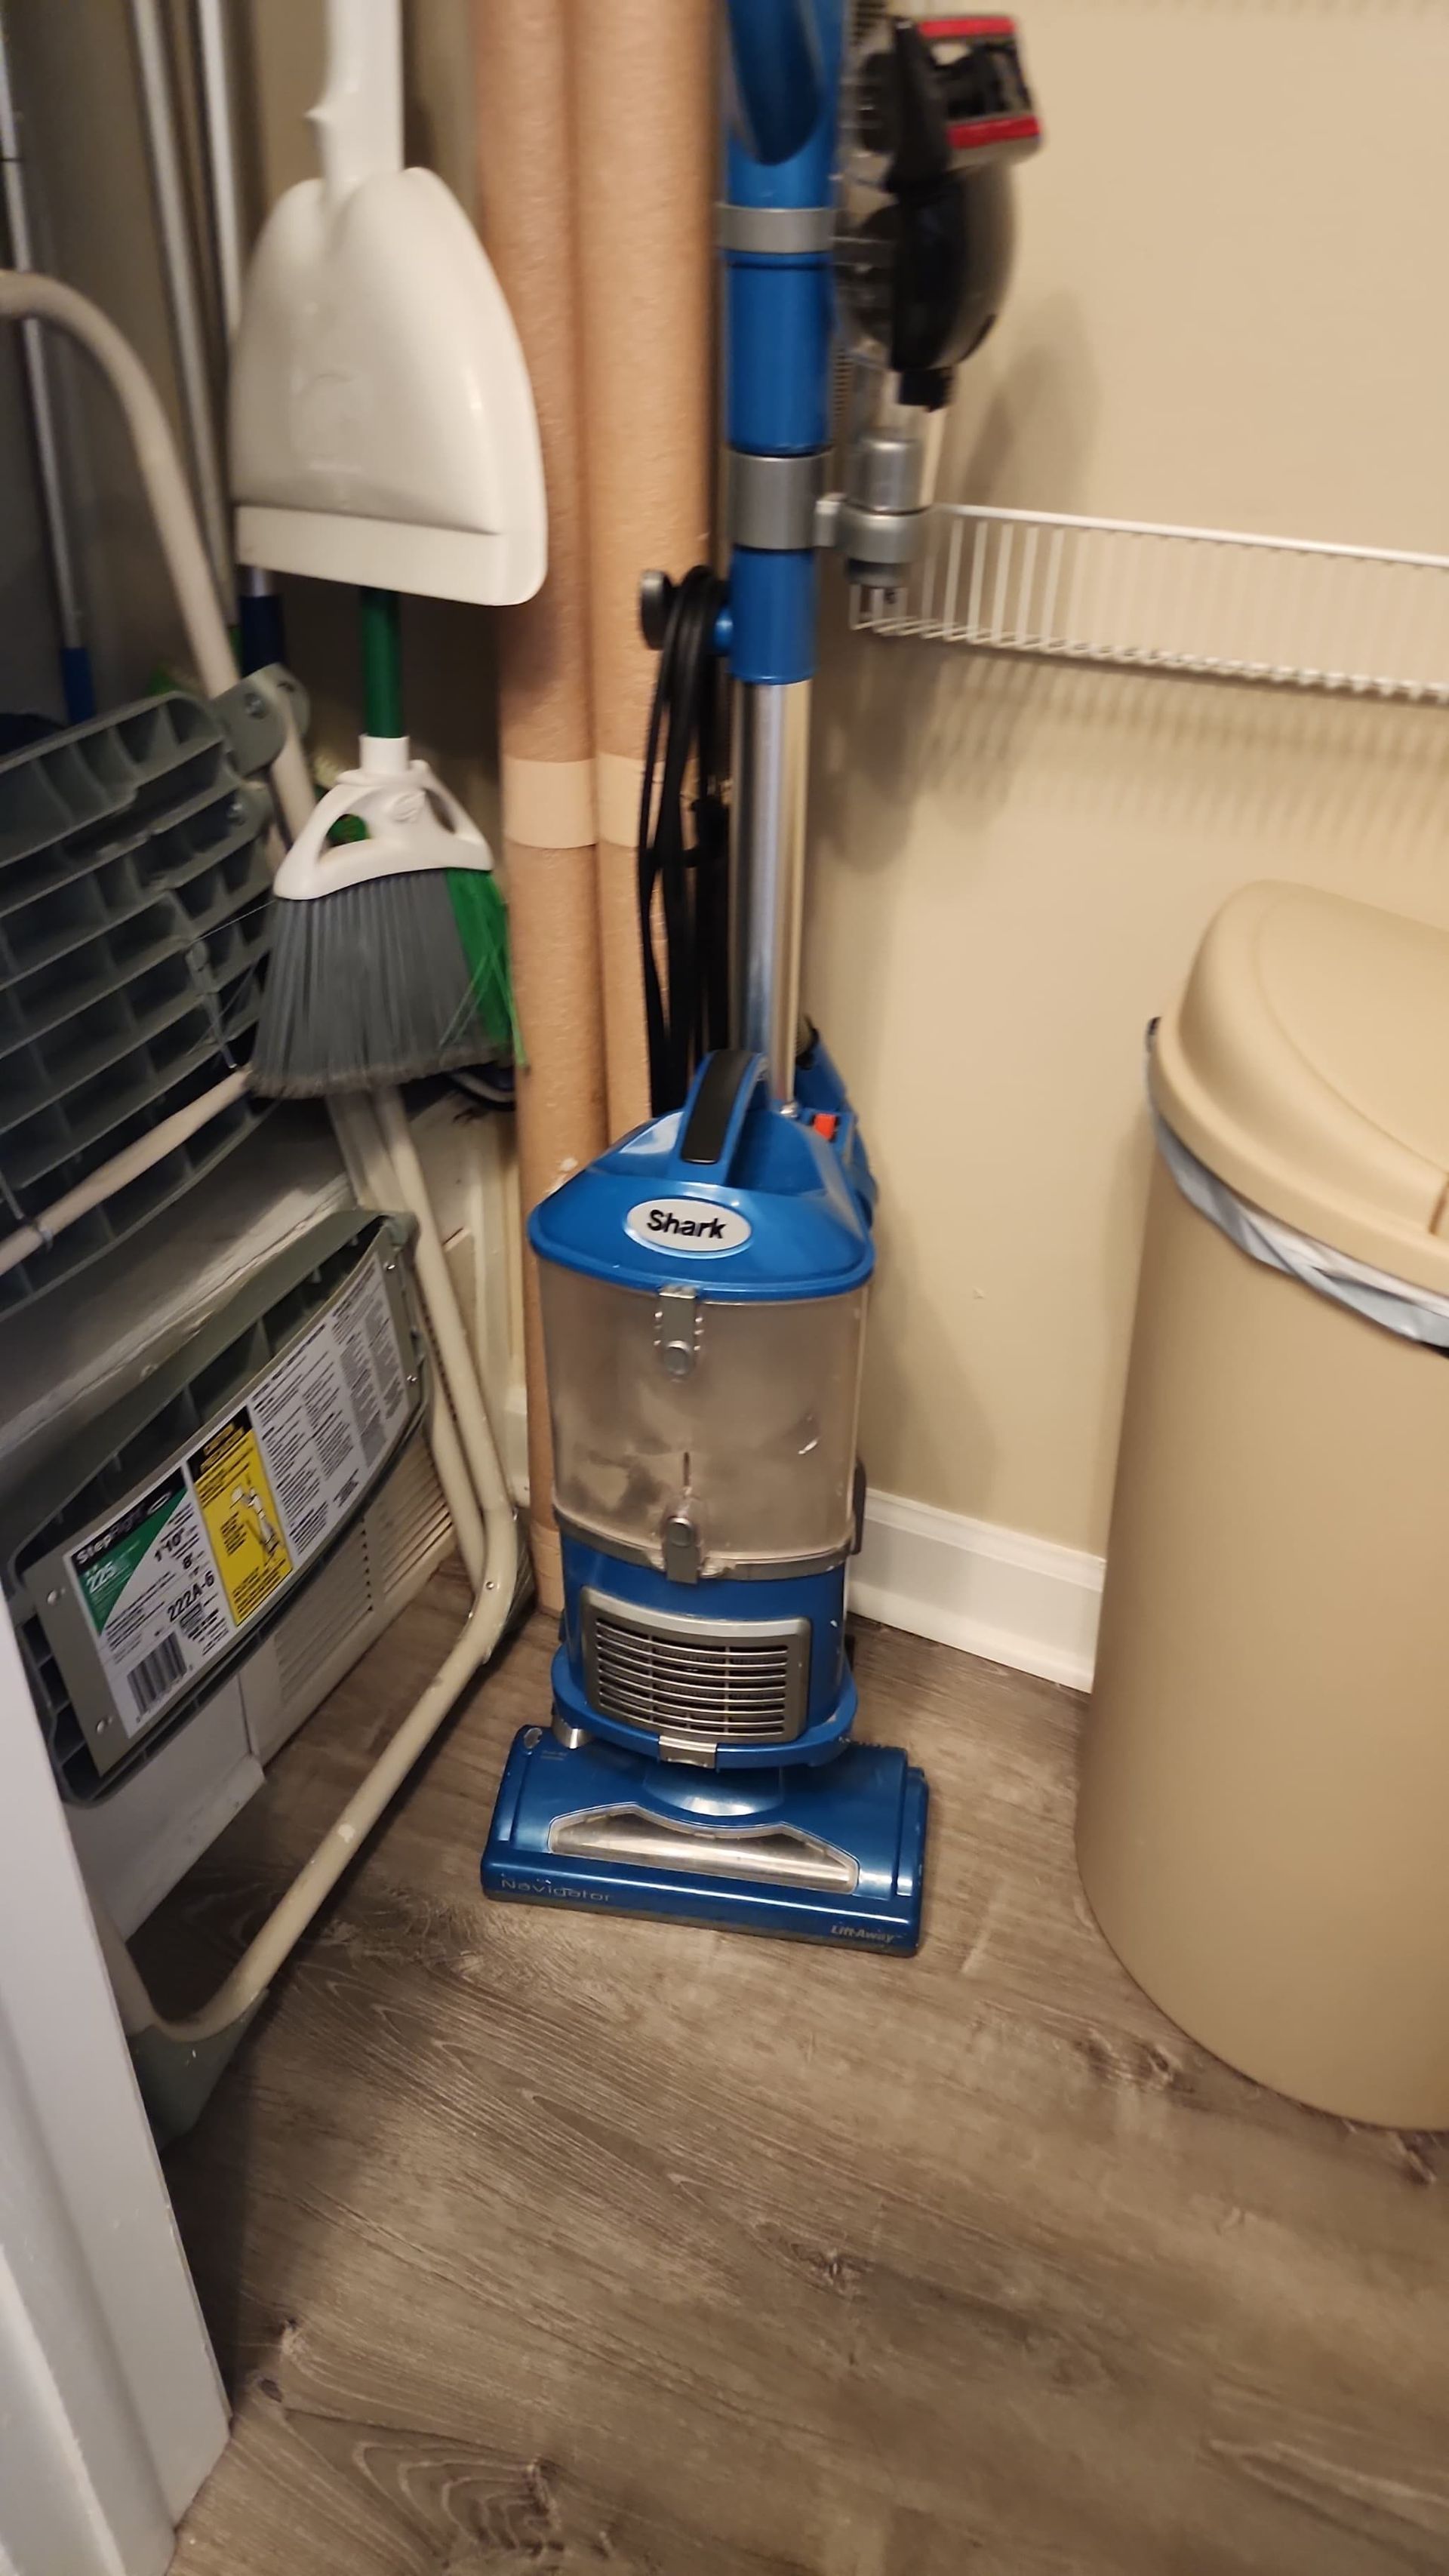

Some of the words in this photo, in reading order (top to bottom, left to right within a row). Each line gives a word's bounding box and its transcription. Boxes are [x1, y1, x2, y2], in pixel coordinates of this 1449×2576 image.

[647, 1209, 727, 1239] Shark
[86, 1560, 116, 1594] 225
[167, 1570, 215, 1623] 222A-6
[501, 1879, 611, 1902] Navigator
